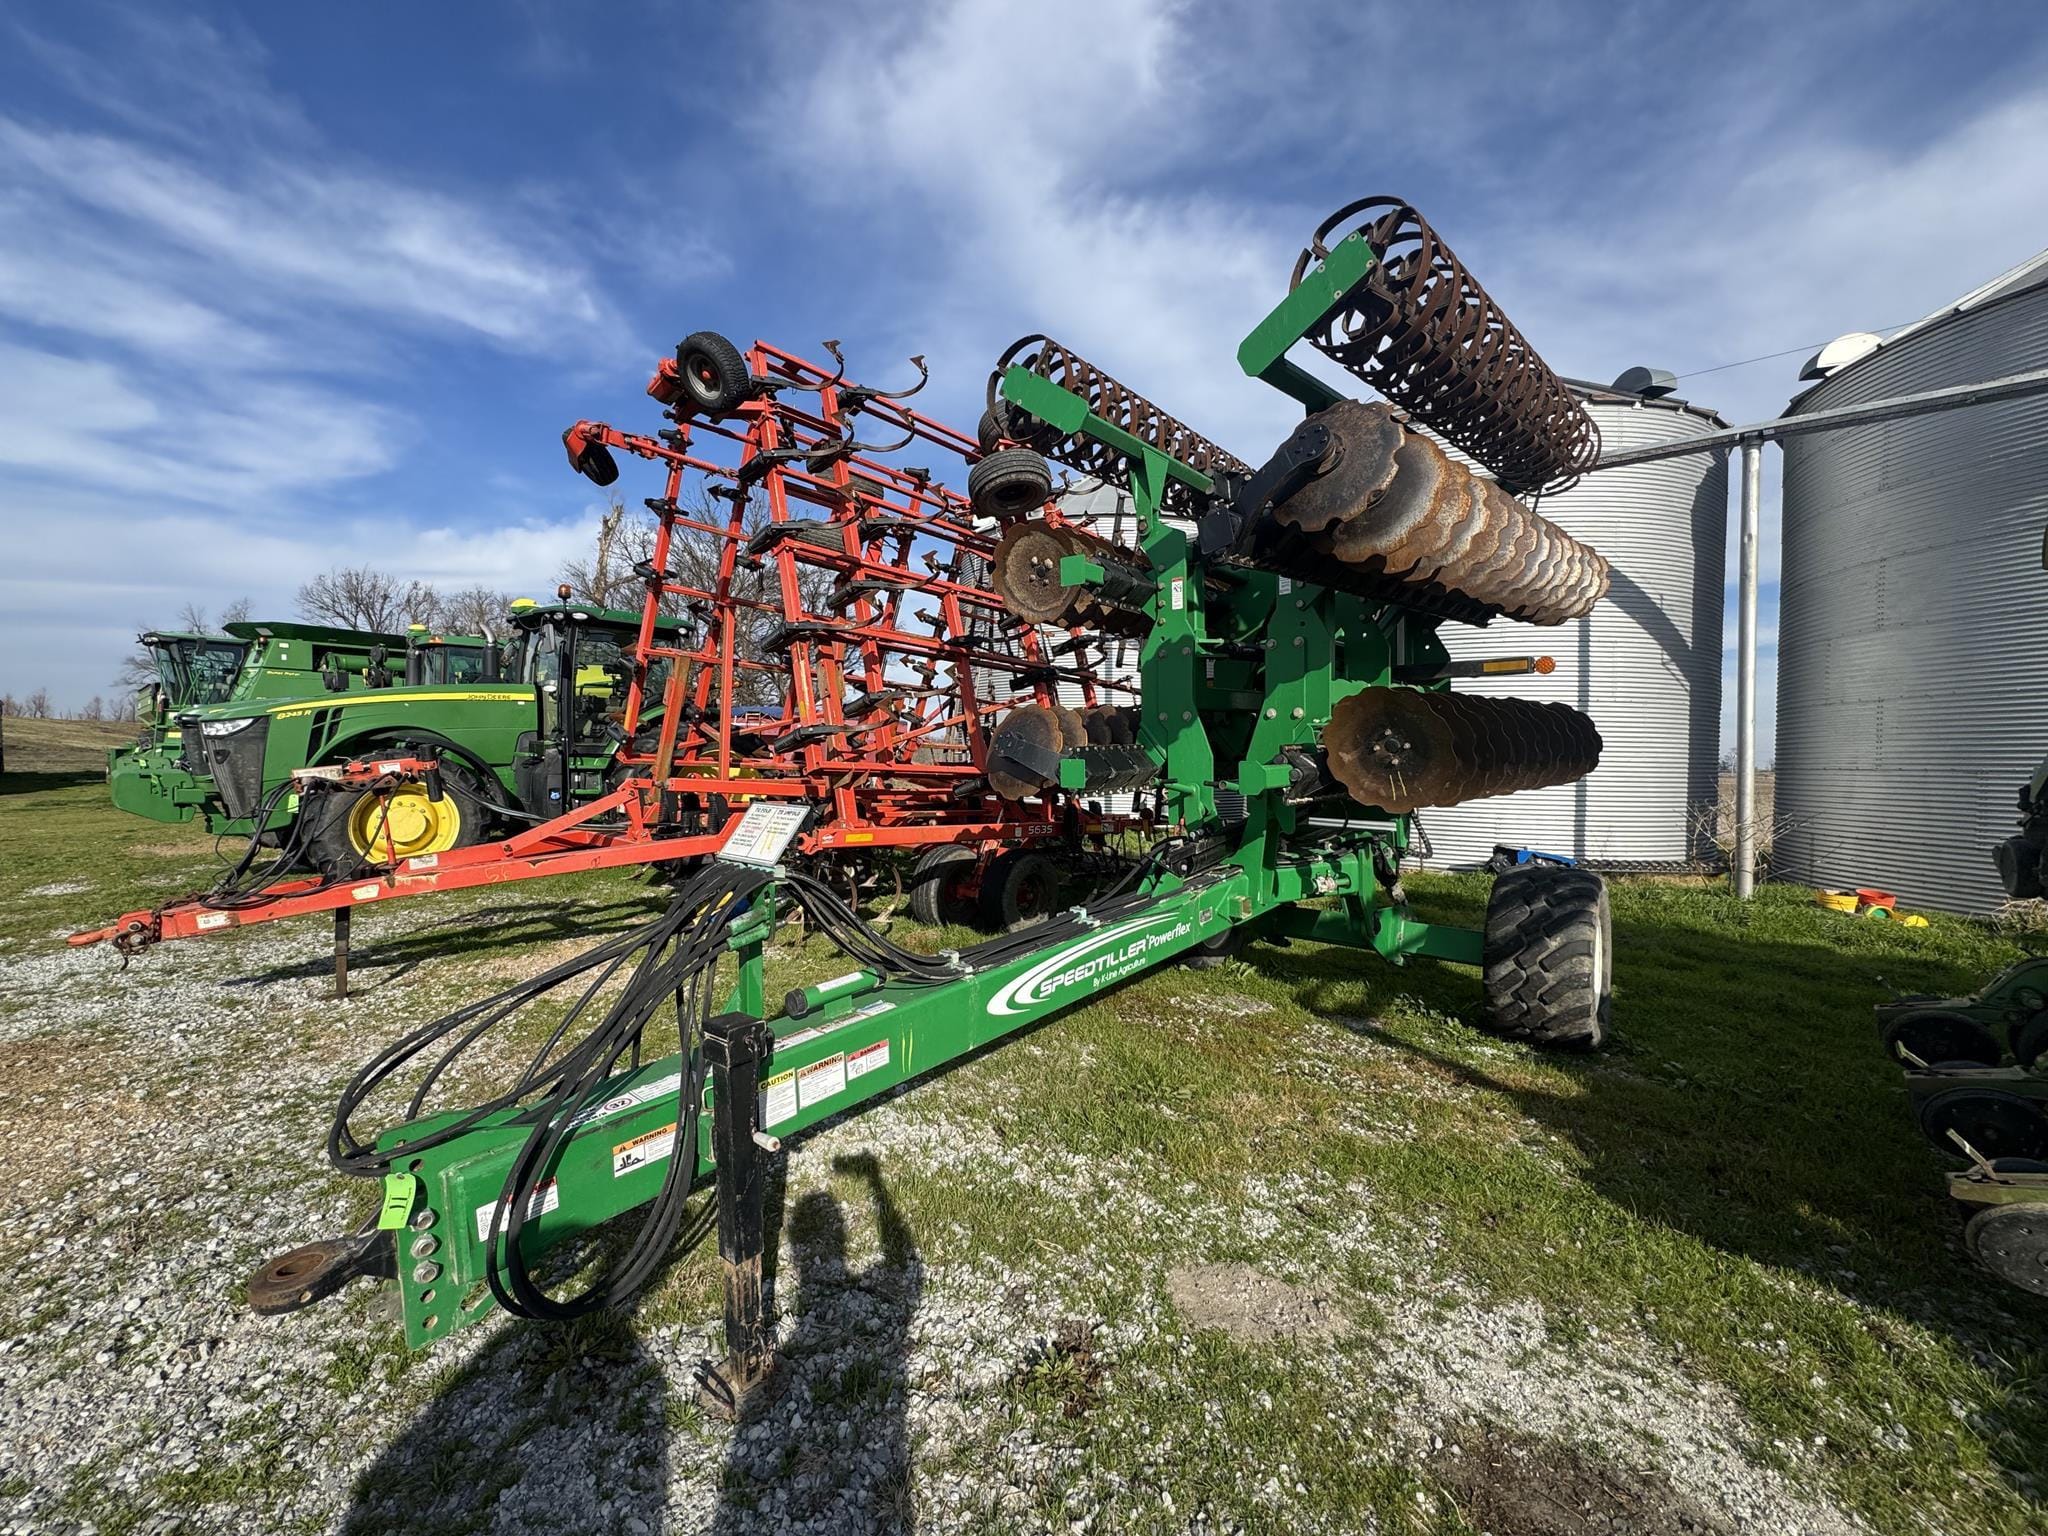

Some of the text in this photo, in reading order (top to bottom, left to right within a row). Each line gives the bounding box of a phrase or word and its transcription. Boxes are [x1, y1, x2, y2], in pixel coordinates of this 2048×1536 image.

[1028, 825, 1053, 835] 5635
[1039, 922, 1192, 998] SPEEDTILLER Powerflex
[1093, 957, 1146, 989] By K-Line Agriculture
[806, 1053, 843, 1077] WARNING
[760, 1071, 794, 1091] CAUTION
[611, 1099, 627, 1109] 32
[631, 1127, 668, 1147] WARNING
